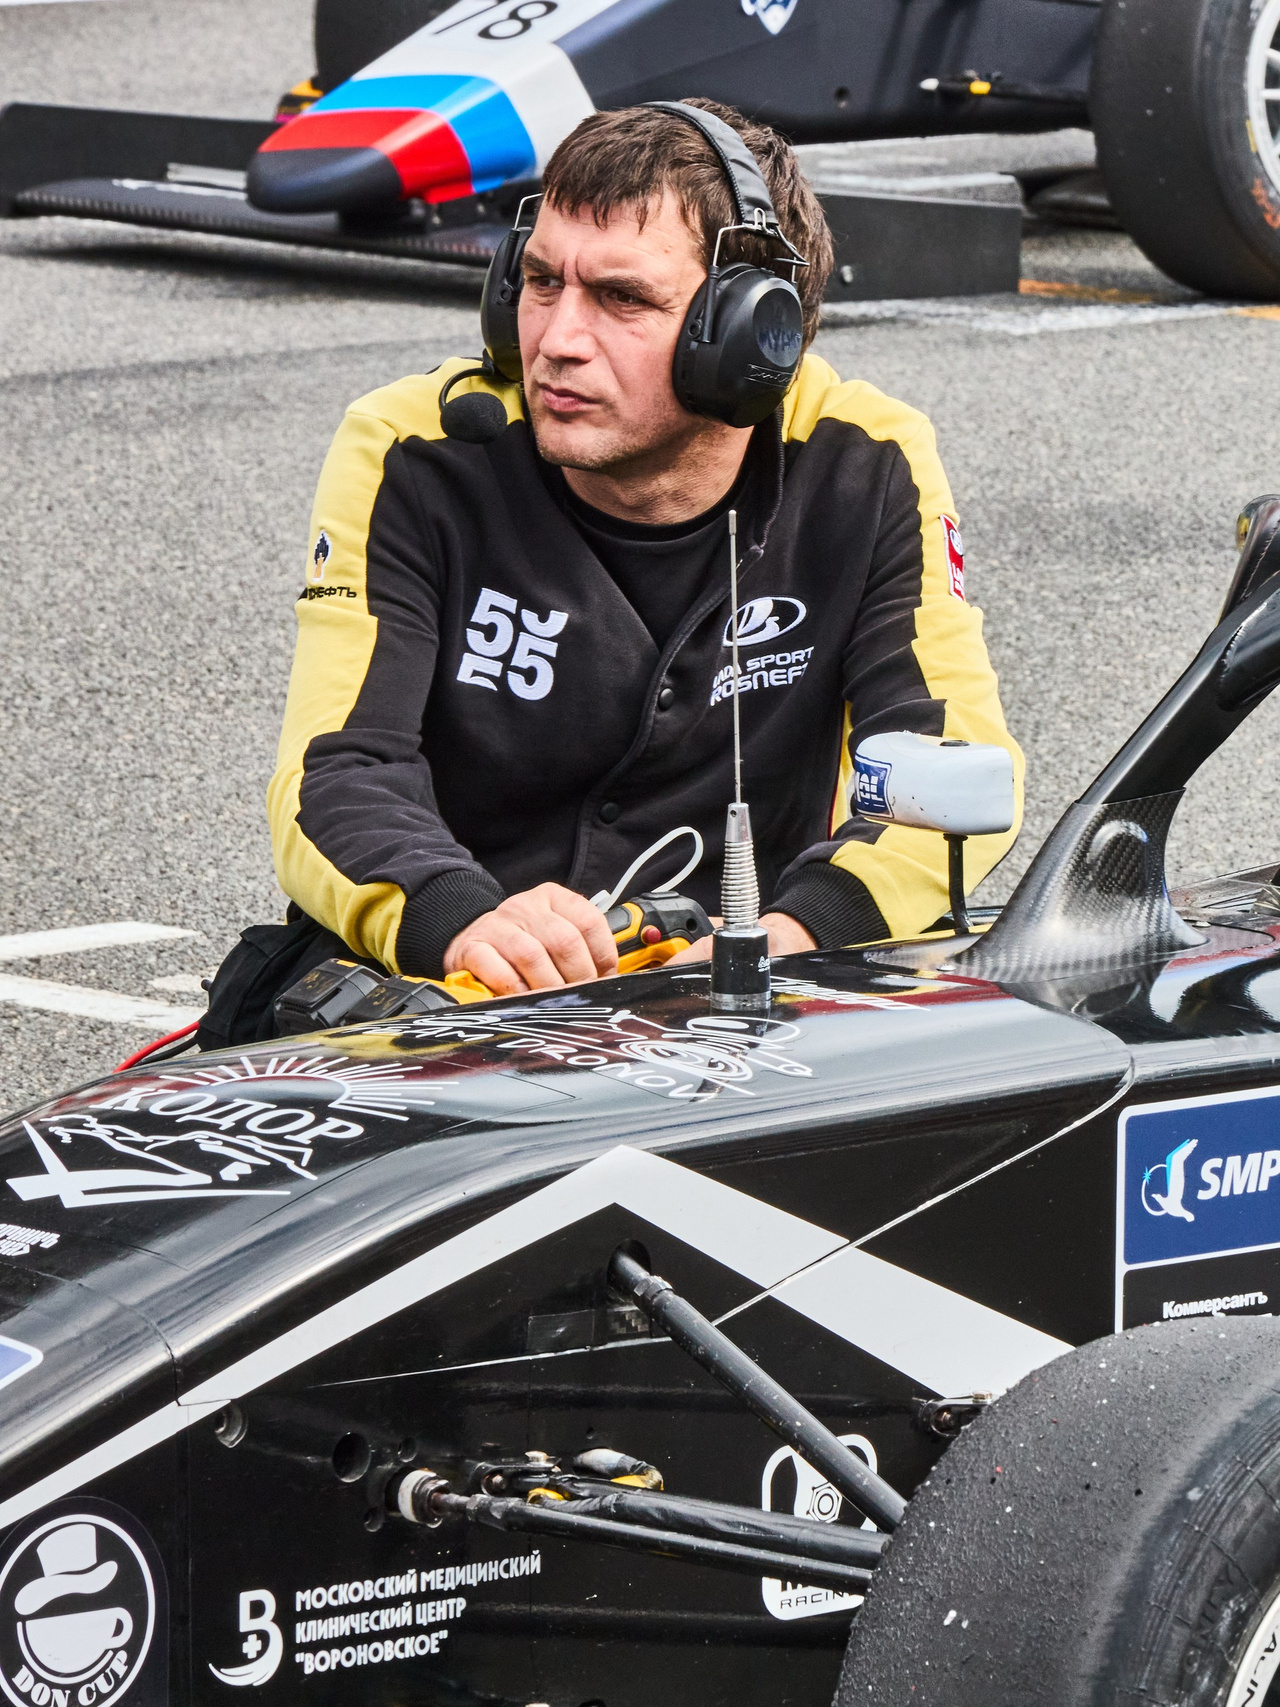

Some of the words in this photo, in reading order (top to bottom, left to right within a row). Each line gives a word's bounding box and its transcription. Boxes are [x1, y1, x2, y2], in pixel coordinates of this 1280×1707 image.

[745, 645, 815, 672] SPORT
[88, 1087, 365, 1145] КОДОР
[1162, 1291, 1268, 1319] Коммерсантъ
[295, 1568, 418, 1612] МОСКОВСКИЙ
[420, 1549, 542, 1594] МЕДИЦИНСКИЙ
[295, 1601, 413, 1644] КЛИНИЧЕСКИЙ
[415, 1596, 467, 1627] ЦЕНТР
[295, 1629, 449, 1675] "ВОРОНОВСКОЕ"
[11, 1664, 71, 1707] DON
[77, 1649, 128, 1706] CUP
